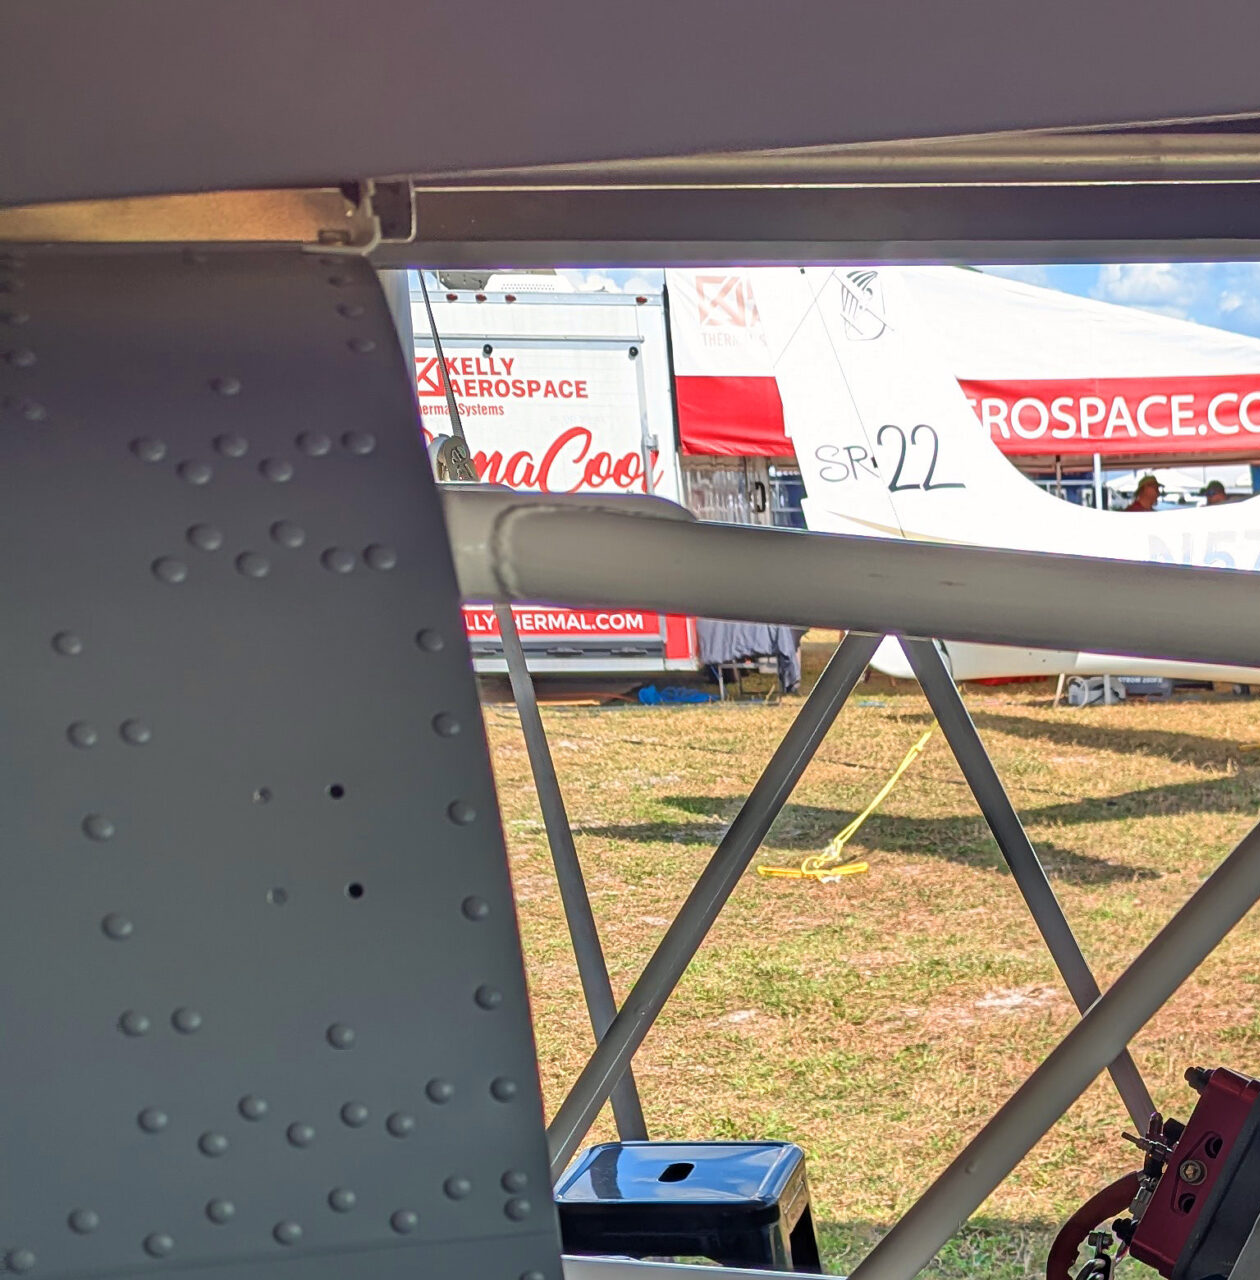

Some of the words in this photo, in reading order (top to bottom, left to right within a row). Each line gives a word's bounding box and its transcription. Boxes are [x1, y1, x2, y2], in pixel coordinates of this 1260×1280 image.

[446, 357, 515, 376] KELLY
[451, 379, 589, 399] AEROSPACE
[458, 402, 505, 417] Systems
